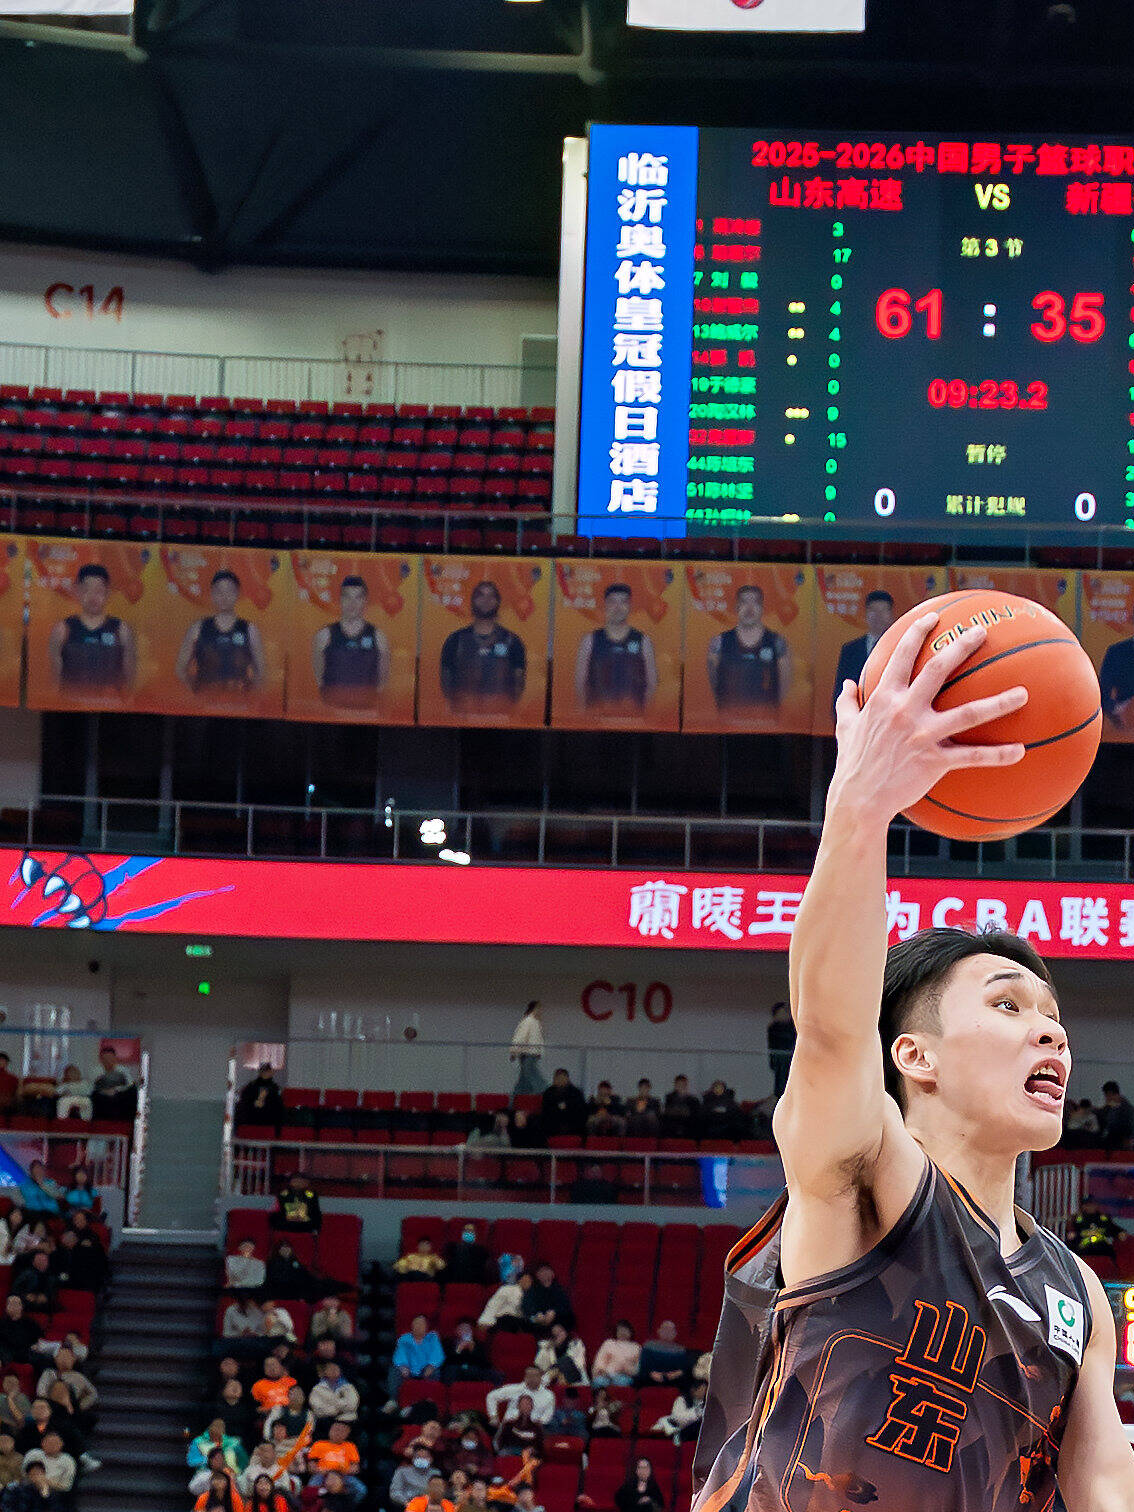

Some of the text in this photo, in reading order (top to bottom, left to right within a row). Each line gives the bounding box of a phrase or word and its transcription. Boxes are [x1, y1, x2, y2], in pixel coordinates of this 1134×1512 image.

[770, 177, 904, 210] 山东高速
[974, 184, 1011, 210] VS
[833, 221, 844, 237] 3
[833, 248, 852, 264] 17
[44, 281, 125, 322] C14
[876, 288, 943, 340] 61
[1031, 291, 1106, 342] 35
[607, 152, 669, 513] 临沂奥体皇冠假日酒店
[928, 379, 1048, 410] 09:23.2
[874, 488, 896, 516] 0
[1074, 492, 1097, 521] 0
[581, 980, 673, 1023] C10
[865, 1299, 987, 1474] 山东
